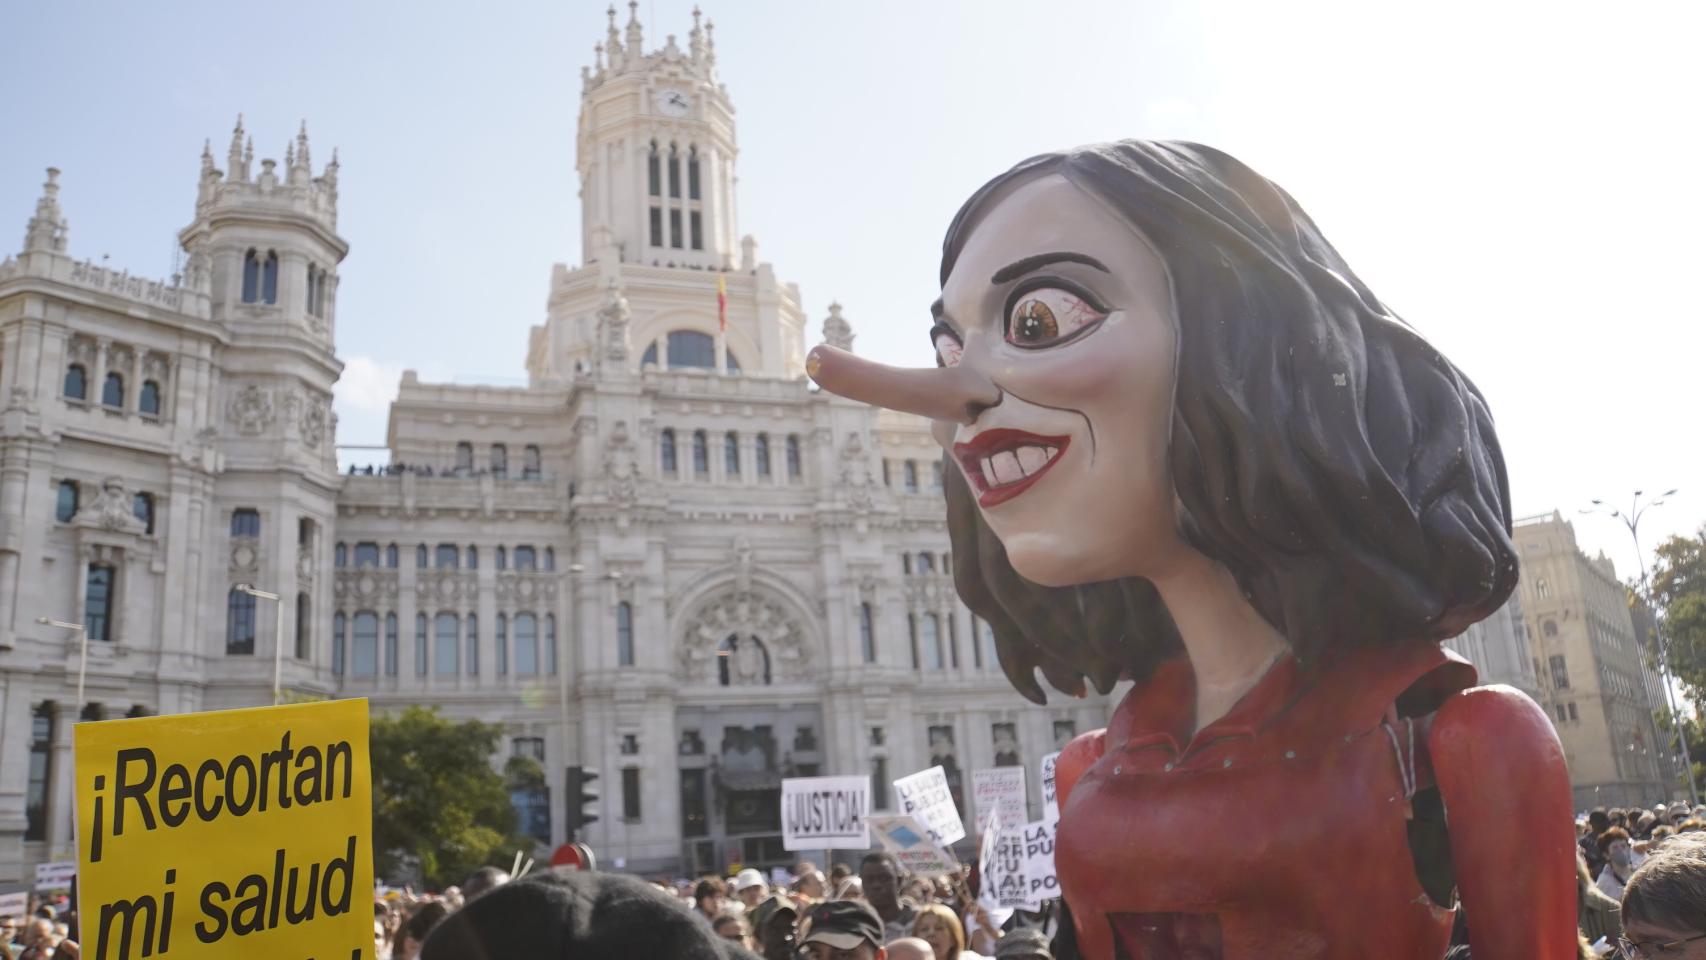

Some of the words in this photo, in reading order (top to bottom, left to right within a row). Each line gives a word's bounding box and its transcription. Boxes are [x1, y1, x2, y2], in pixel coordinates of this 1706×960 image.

[90, 730, 352, 863] ¡Recortan
[1025, 826, 1048, 842] LA
[96, 869, 177, 960] mi
[195, 836, 356, 944] salud
